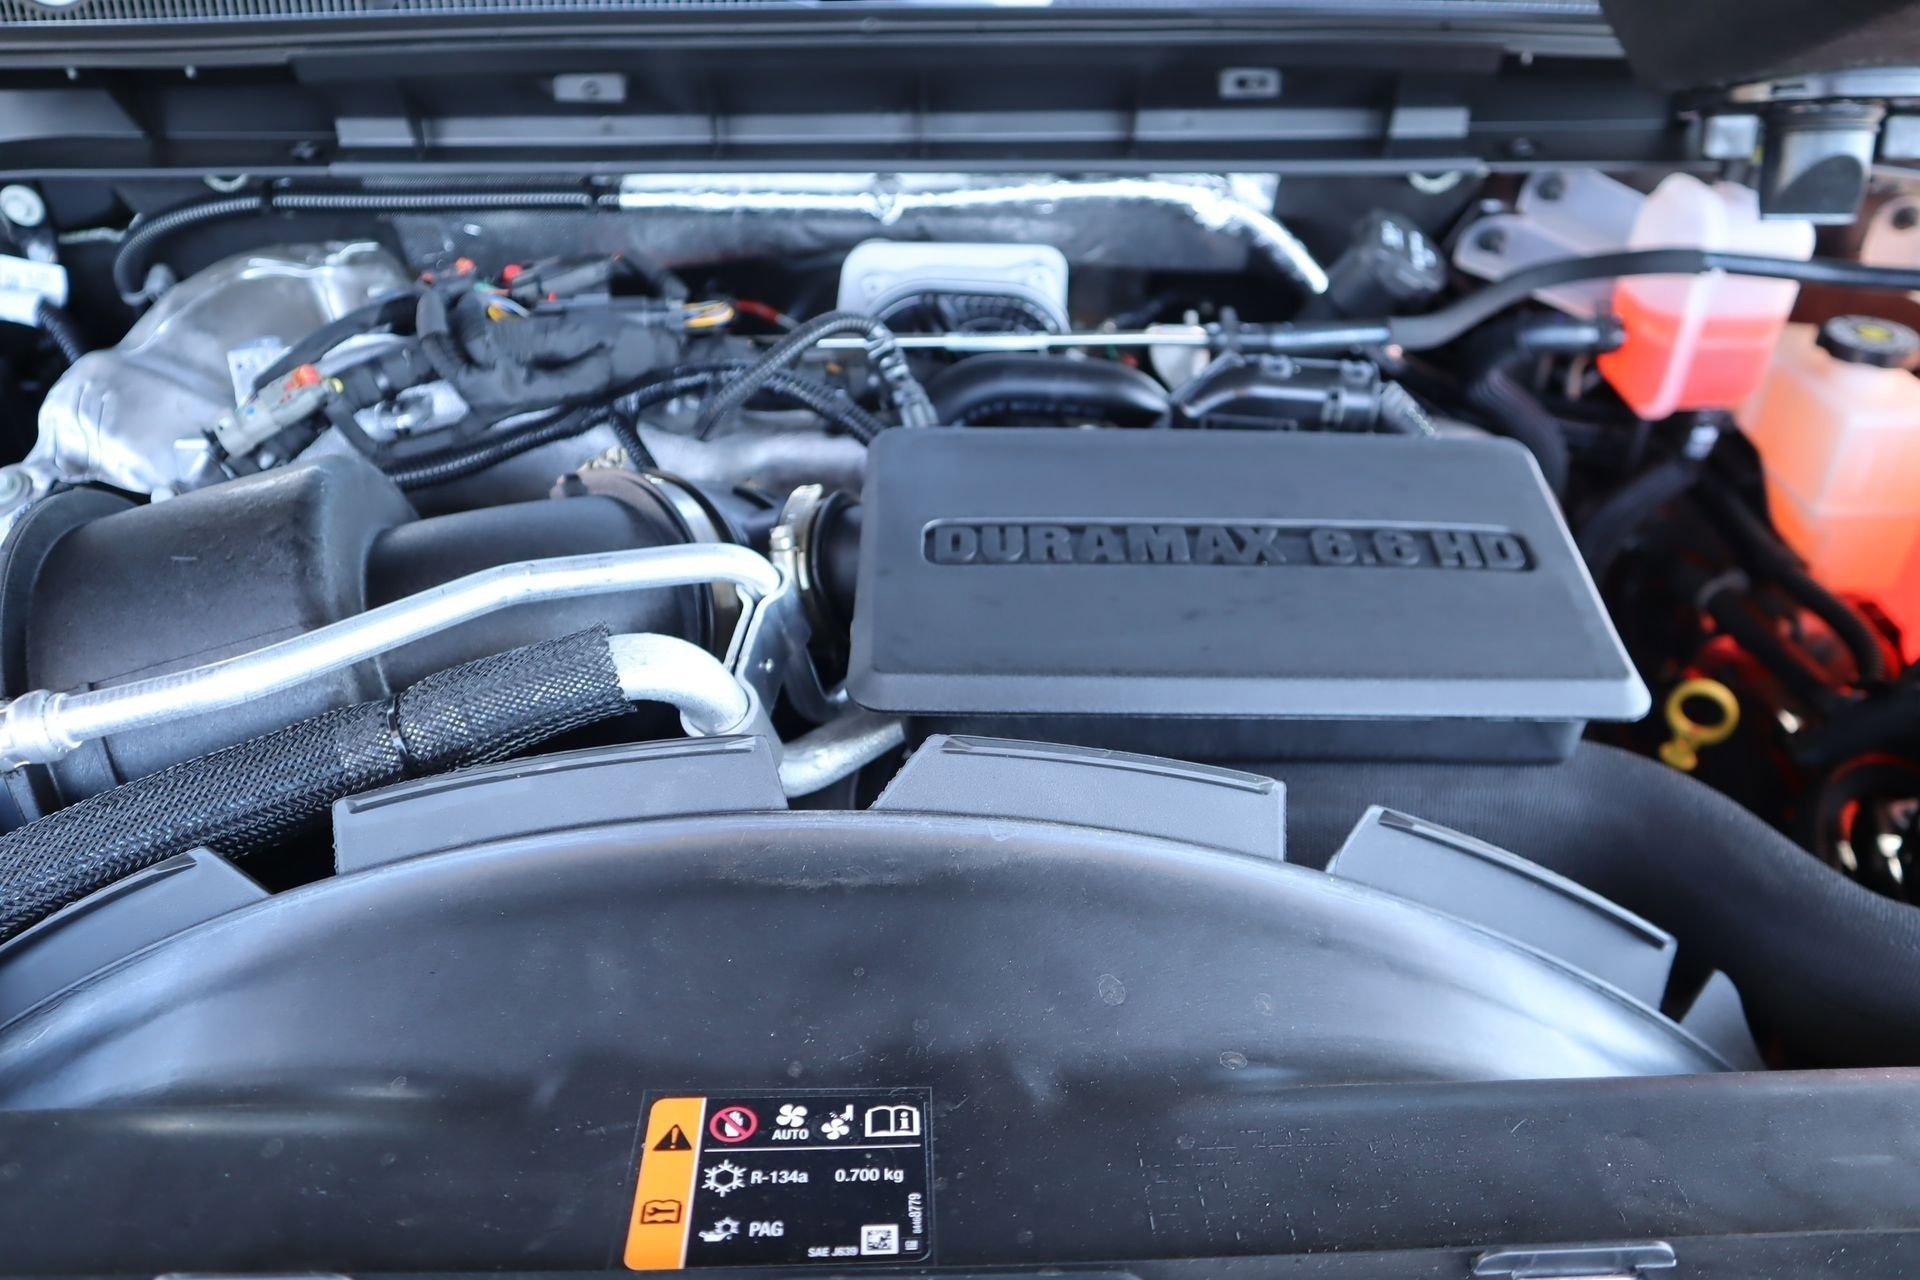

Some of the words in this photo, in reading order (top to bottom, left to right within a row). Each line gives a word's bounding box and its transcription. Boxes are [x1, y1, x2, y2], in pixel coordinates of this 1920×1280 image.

[934, 525, 1285, 563] DURAMAX
[1310, 527, 1420, 566] 6.6
[1430, 530, 1527, 568] HD
[772, 1128, 809, 1140] AUTO
[750, 1170, 808, 1183] R-134a
[834, 1168, 879, 1182] 0.700
[883, 1168, 904, 1183] kg
[748, 1221, 784, 1237] PAG
[808, 1246, 830, 1257] SAE
